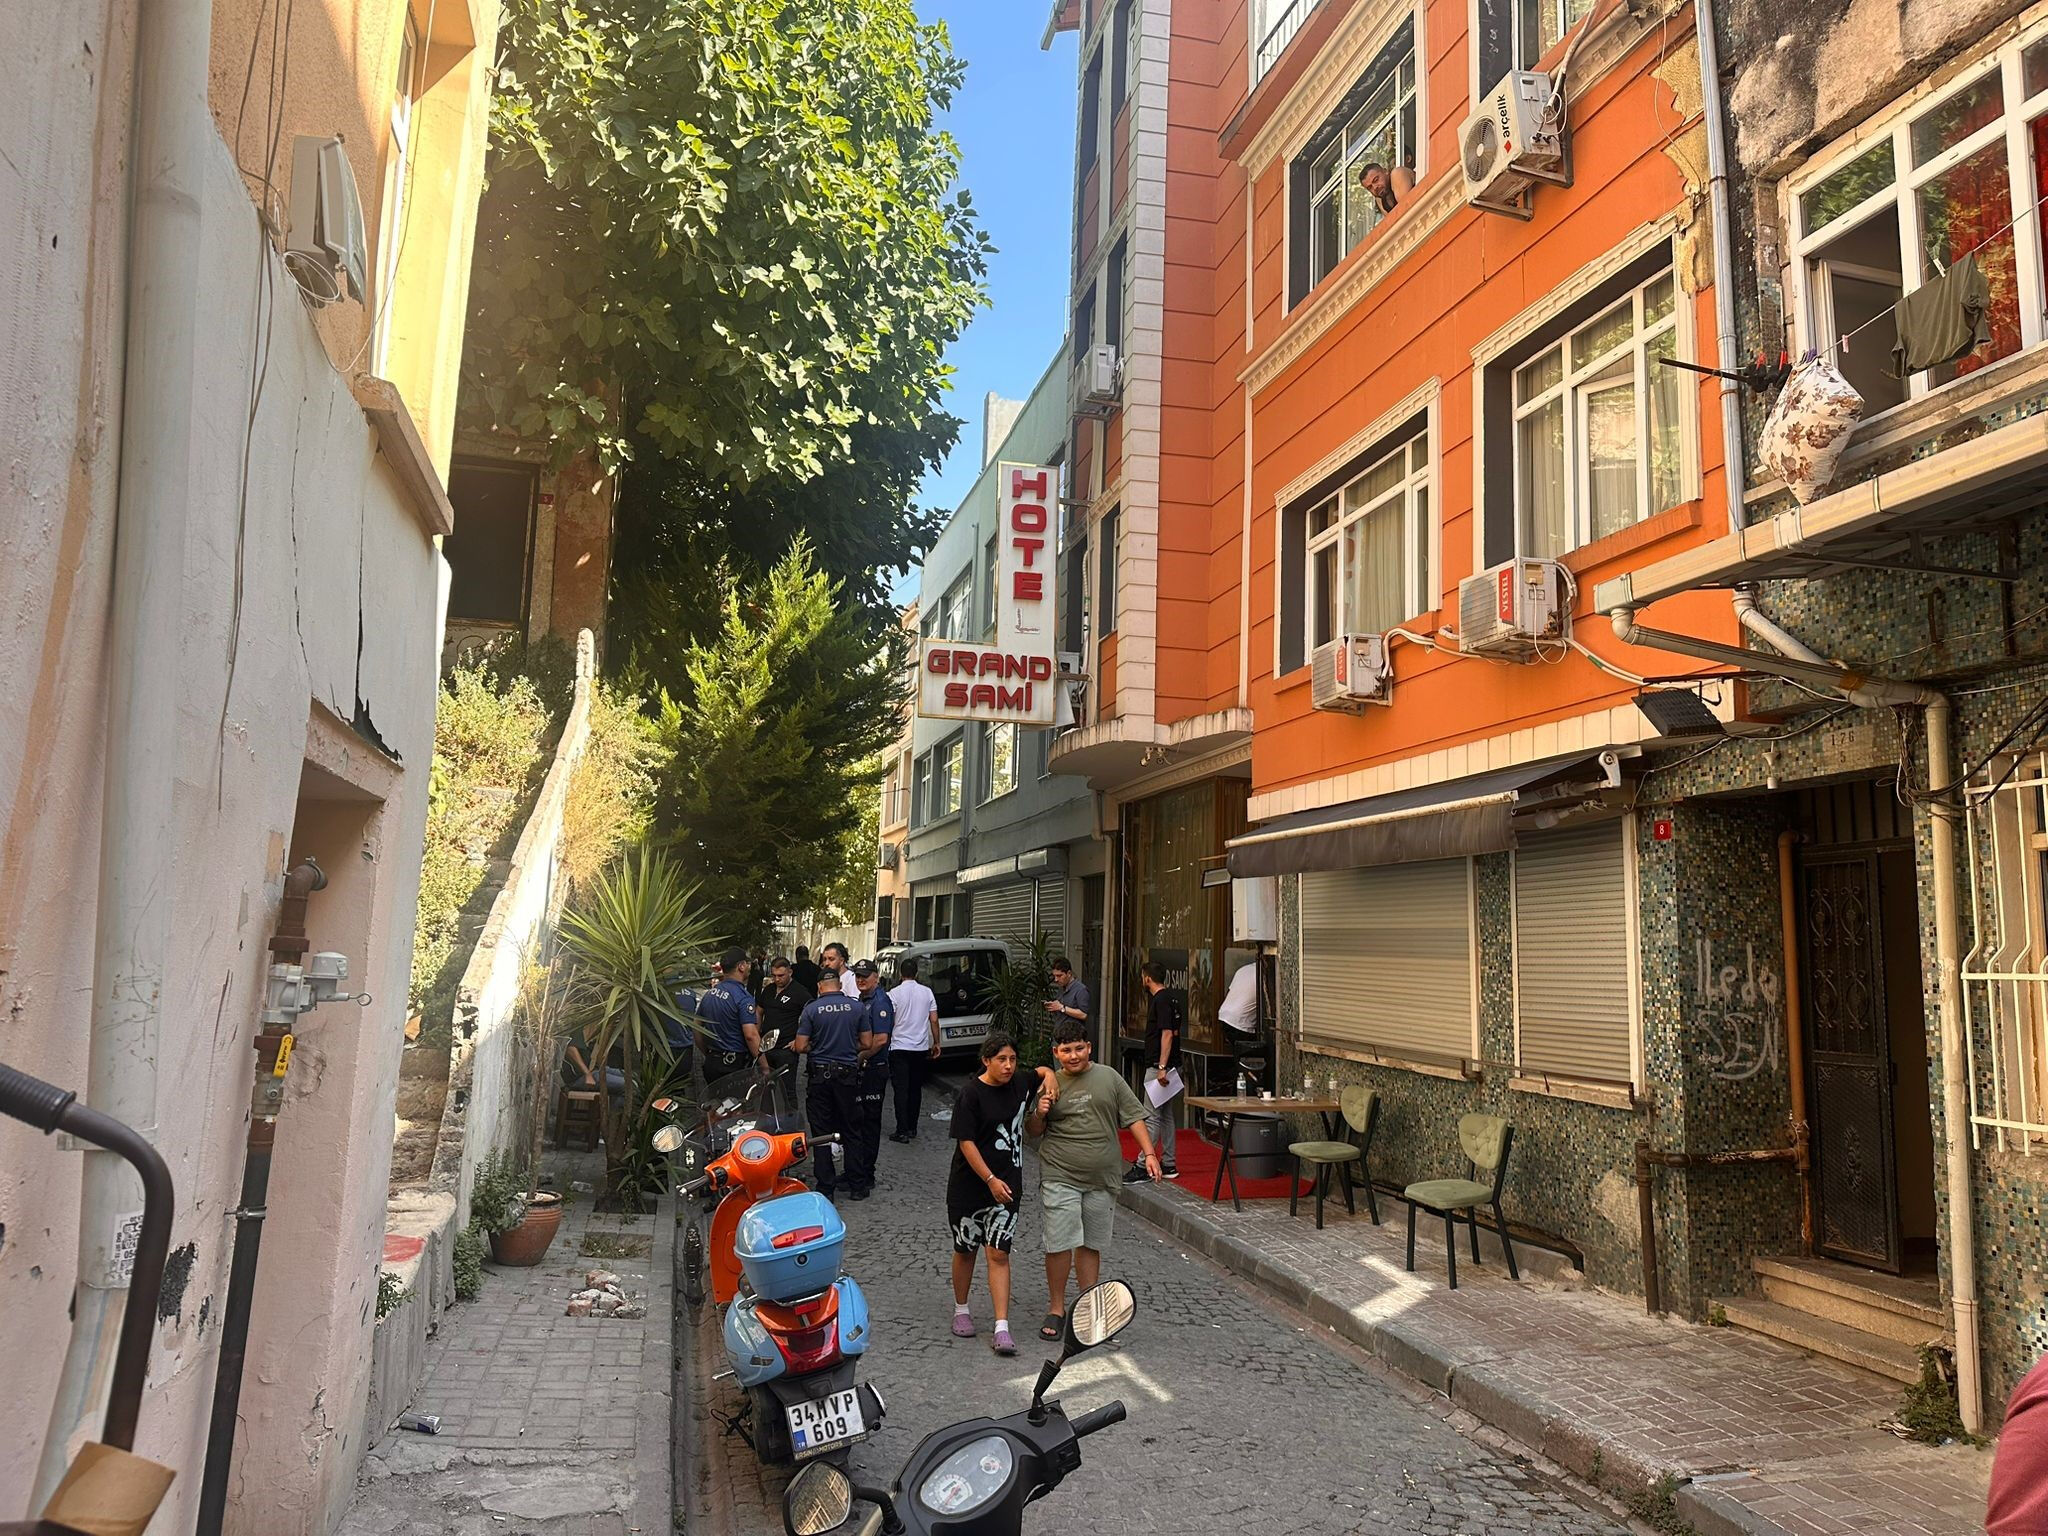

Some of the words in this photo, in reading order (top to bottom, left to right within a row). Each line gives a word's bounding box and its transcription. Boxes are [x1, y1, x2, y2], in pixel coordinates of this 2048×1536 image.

[1497, 94, 1511, 138] arçelik
[1501, 574, 1509, 613] VESTEL
[927, 648, 1052, 681] GRAND
[944, 682, 1033, 712] SAMİ
[1659, 824, 1665, 835] 8
[812, 1416, 848, 1443] 609
